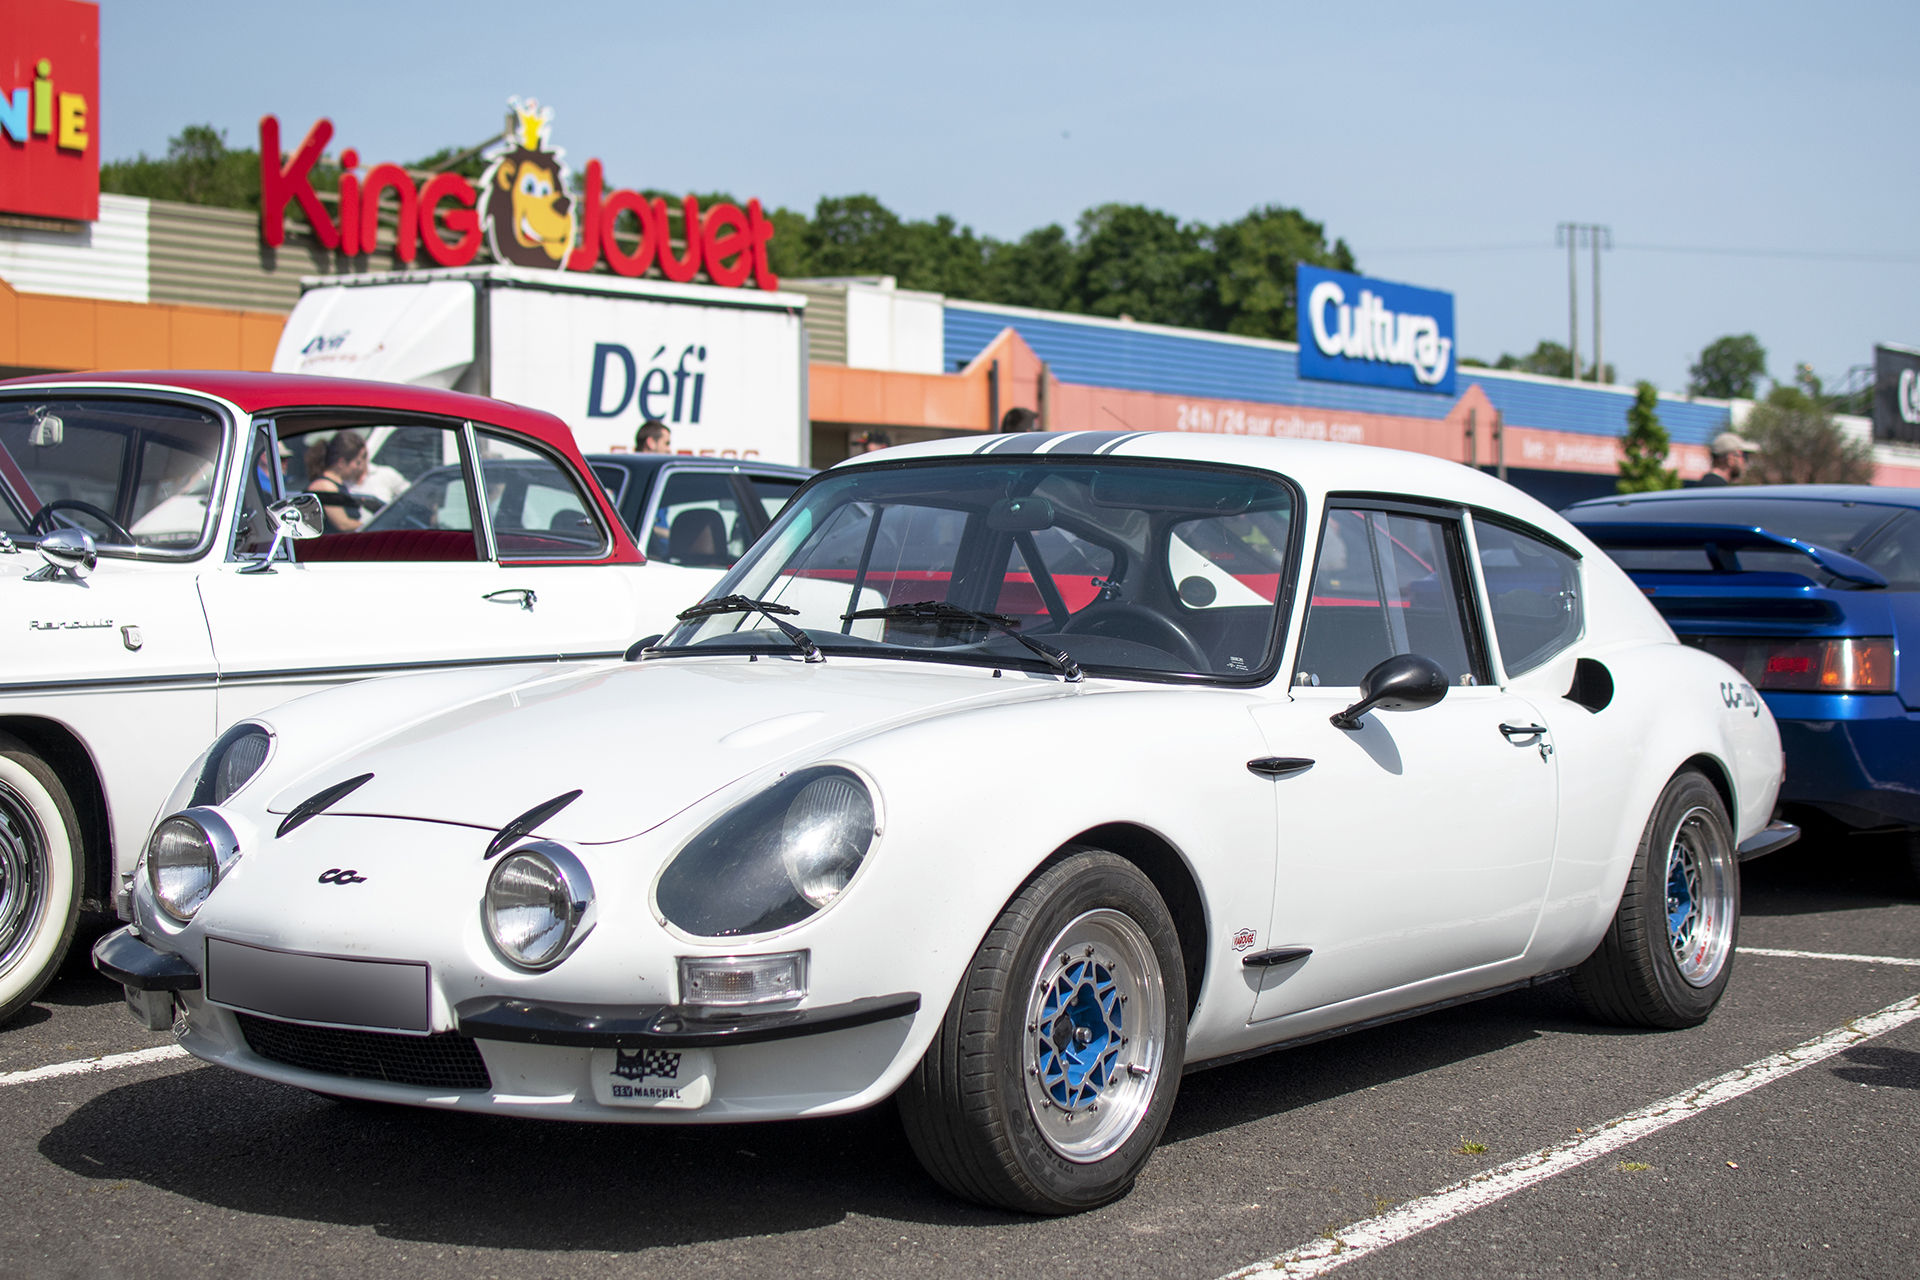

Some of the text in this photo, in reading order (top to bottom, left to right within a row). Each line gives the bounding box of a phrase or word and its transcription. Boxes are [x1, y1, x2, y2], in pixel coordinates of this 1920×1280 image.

[567, 158, 779, 292] Jouet
[1309, 281, 1452, 385] Cultura
[587, 342, 707, 424] Défi
[613, 1086, 681, 1099] SEV MARCHAL
[1011, 1109, 1057, 1187] TOYO
